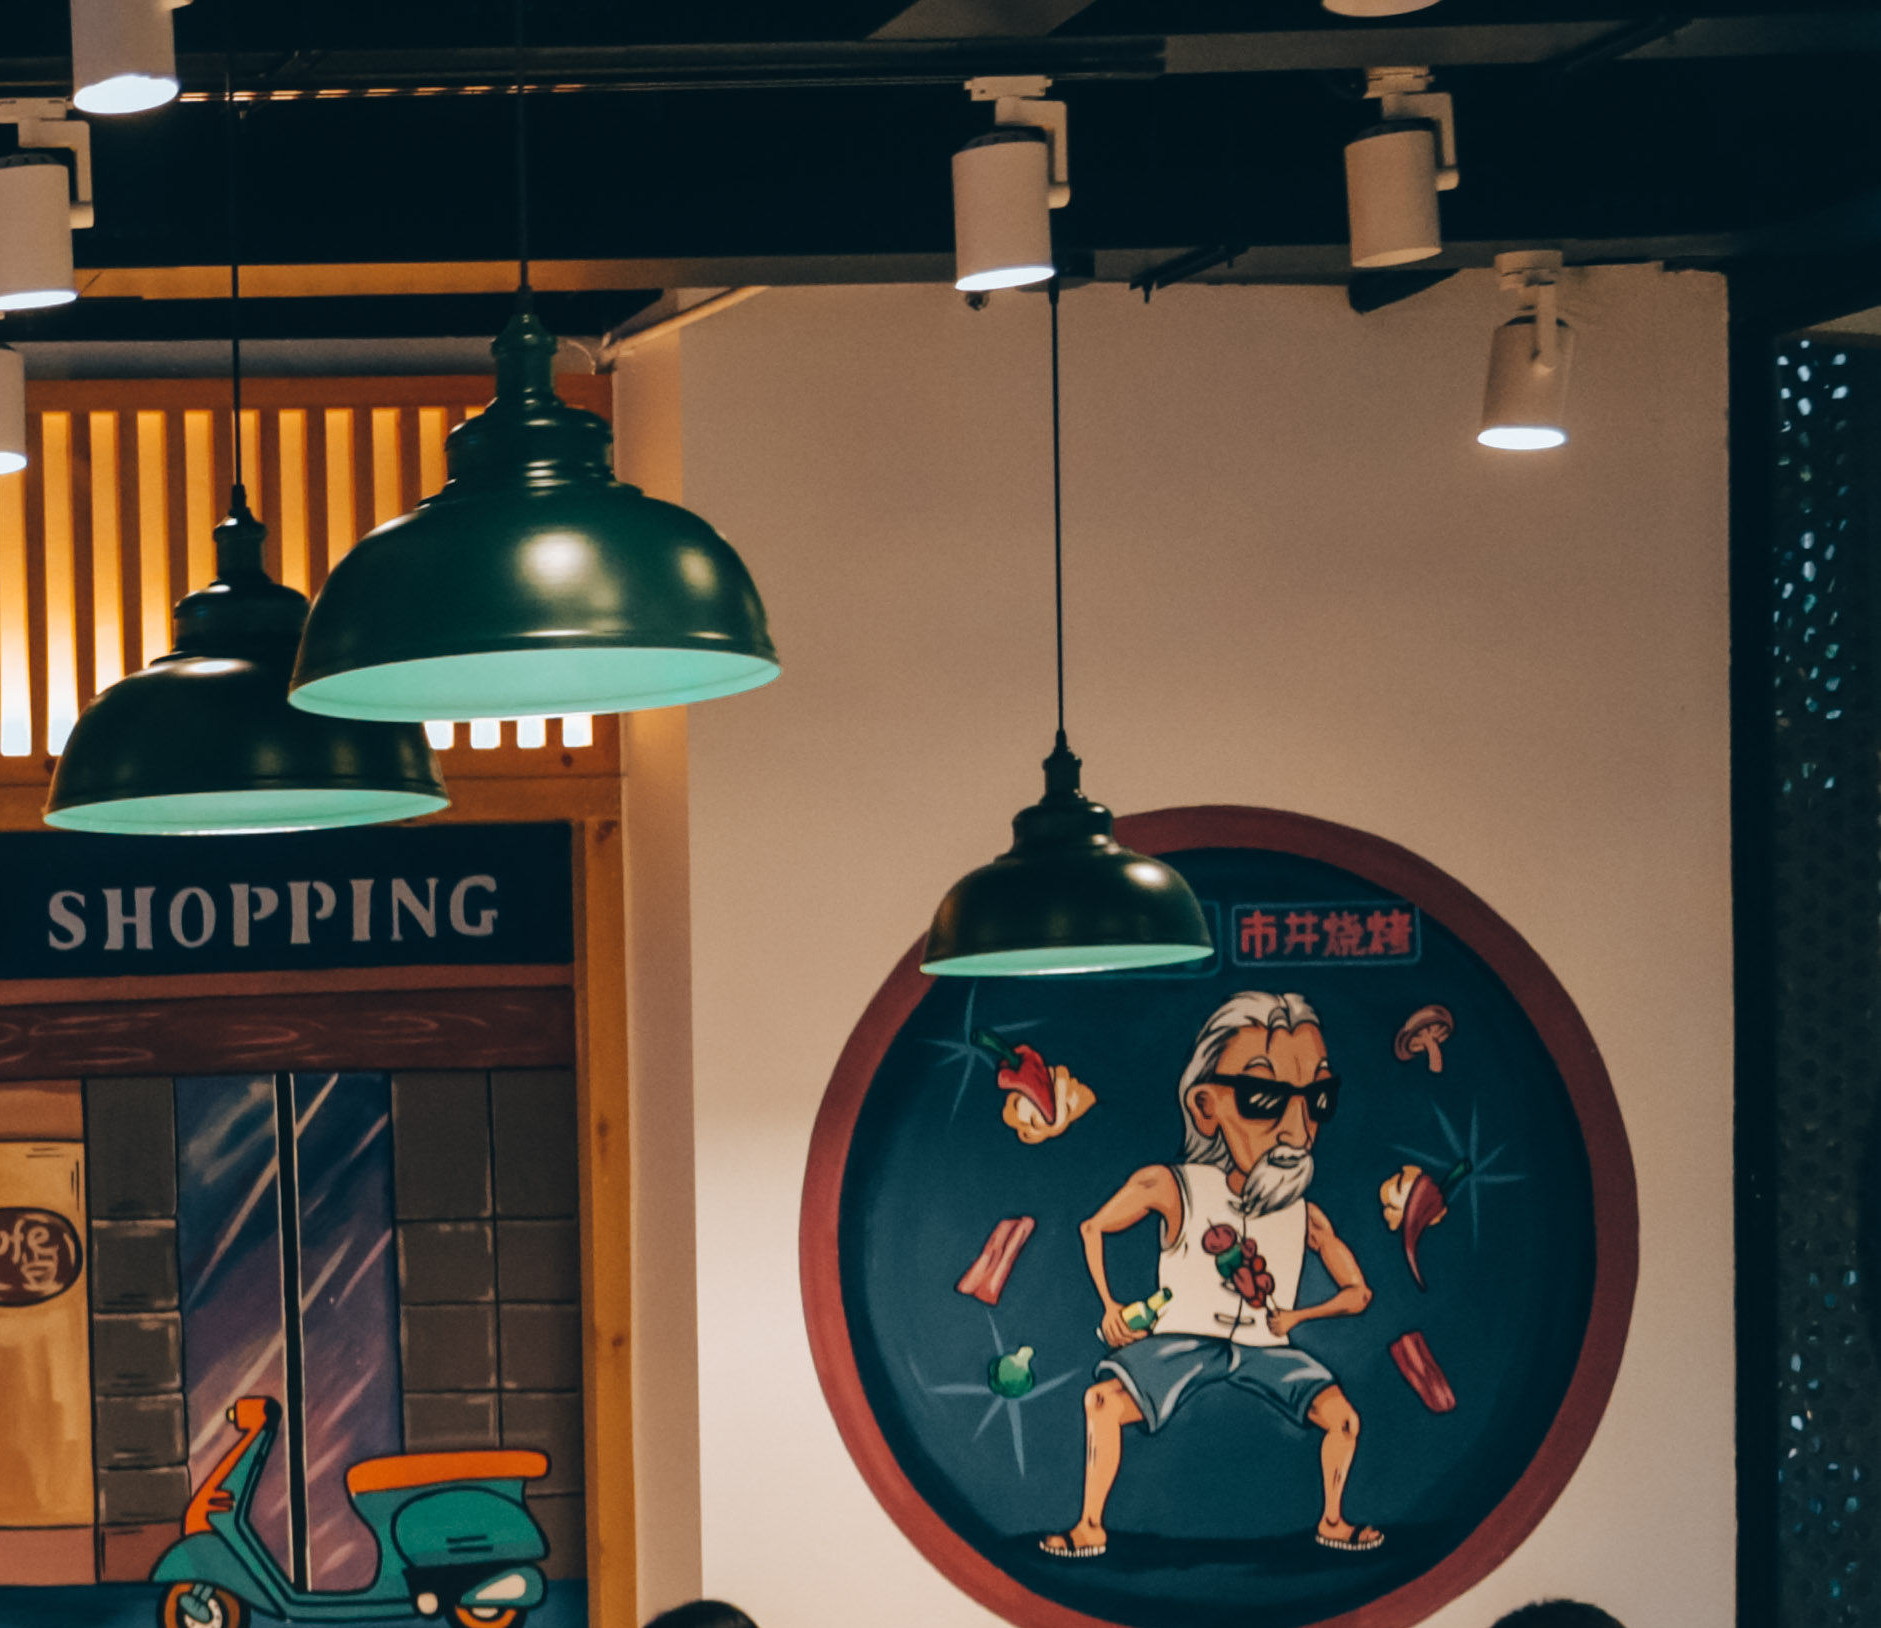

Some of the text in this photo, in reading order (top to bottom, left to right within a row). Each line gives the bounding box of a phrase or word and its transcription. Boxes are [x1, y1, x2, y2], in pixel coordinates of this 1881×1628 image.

[47, 875, 499, 951] SHOPPING
[1241, 909, 1413, 959] 市井烧烤
